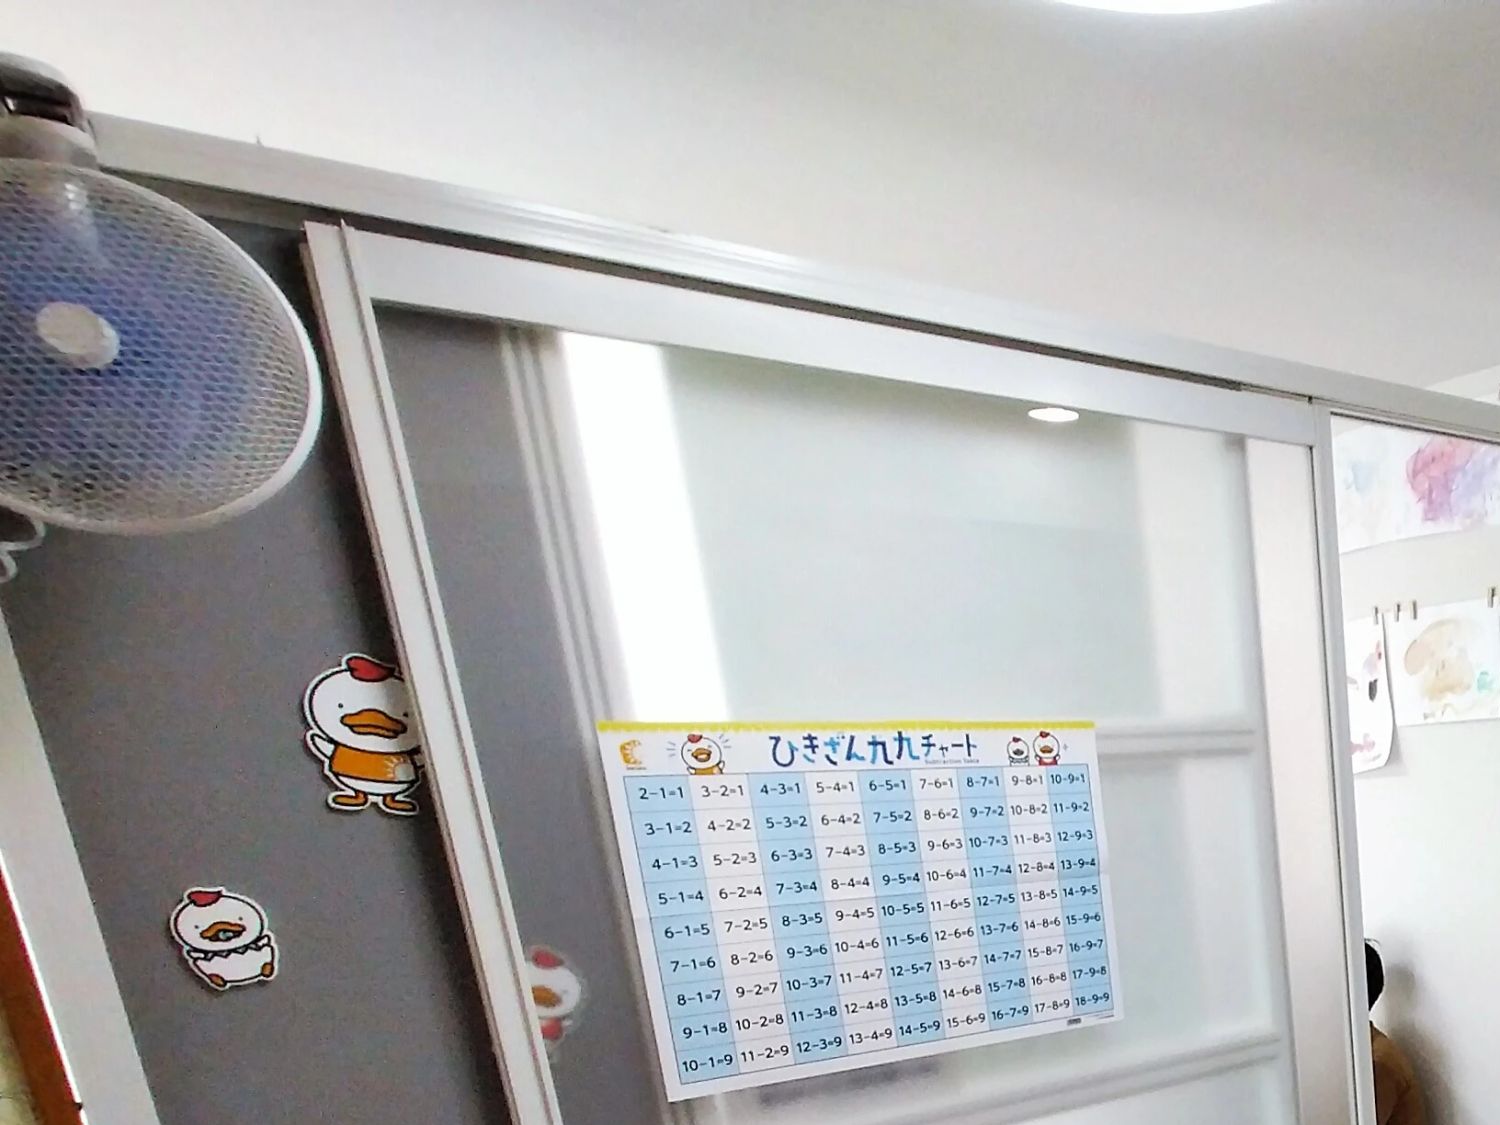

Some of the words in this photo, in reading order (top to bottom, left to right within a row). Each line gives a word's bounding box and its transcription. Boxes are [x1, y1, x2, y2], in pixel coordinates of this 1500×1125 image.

[769, 731, 978, 767] ひきざん九九チャート
[637, 785, 684, 801] 2-1=1
[700, 784, 744, 798] 3-2=1
[759, 782, 801, 796] 4-3=1
[815, 780, 855, 794] 5-4=1
[868, 778, 907, 792] 6-5=1
[919, 777, 954, 790] 7-6=1
[966, 775, 1000, 788] 8-7=1
[1011, 774, 1044, 787] 9-8=1
[1049, 772, 1086, 785] 10-9=1
[643, 820, 693, 836] 3-1=2
[707, 817, 752, 832] 4-2=2
[765, 815, 809, 830] 5-3=2
[820, 812, 862, 827] 6-4=2
[872, 809, 913, 824] 7-5=2
[923, 807, 960, 821] 8-6=2
[969, 804, 1005, 819] 9-7=2
[1010, 803, 1048, 816] 10-8=2
[1053, 801, 1089, 815] 11-9=2
[651, 855, 699, 871] 4-1=3
[712, 851, 757, 867] 5-2=3
[770, 847, 814, 863] 6-3=3
[825, 844, 866, 859] 7-4=3
[877, 840, 917, 855] 8-5=3
[927, 837, 964, 852] 9-6=3
[968, 834, 1009, 849] 10-7=3
[1013, 831, 1052, 845] 11-8=3
[1056, 828, 1094, 842] 12-9=3
[657, 889, 705, 906] 5-1=4
[718, 885, 763, 900] 6-2=4
[775, 880, 818, 896] 7-3=4
[830, 876, 871, 891] 8-4=4
[881, 871, 921, 886] 9-5=4
[926, 868, 967, 882] 10-6=4
[972, 863, 1013, 878] 11-7=4
[1017, 861, 1056, 874] 12-8=4
[1059, 857, 1096, 870] 13-9=4
[663, 922, 711, 940] 6-1=5
[723, 917, 769, 933] 7-2=5
[781, 911, 824, 928] 8-3=5
[834, 906, 875, 922] 9-4=5
[880, 901, 925, 917] 10-5=5
[930, 897, 972, 912] 11-6=5
[976, 892, 1016, 907] 12-7=5
[1020, 888, 1058, 903] 13-8=5
[1062, 884, 1099, 898] 14-9=5
[669, 955, 717, 973] 7-1=6
[730, 949, 774, 966] 8-2=6
[786, 943, 829, 959] 9-3=6
[834, 937, 880, 953] 10-4=6
[885, 931, 929, 948] 11-5=6
[934, 926, 975, 942] 12-6=6
[979, 921, 1020, 936] 13-7=6
[1024, 916, 1062, 931] 14-8=6
[1065, 911, 1102, 926] 15-9=6
[676, 988, 722, 1007] 8-1=7
[735, 981, 779, 999] 9-2=7
[785, 974, 832, 992] 10-3=7
[839, 967, 884, 984] 11-4=7
[889, 961, 933, 978] 12-5=7
[938, 955, 978, 971] 13-6=7
[983, 949, 1022, 965] 14-7=7
[1027, 943, 1064, 959] 15-8=7
[1068, 938, 1104, 953] 16-9=7
[682, 1021, 729, 1040] 9-1=8
[735, 1013, 785, 1031] 10-2=8
[790, 1005, 838, 1023] 11-3=8
[844, 997, 889, 1015] 12-4=8
[893, 990, 938, 1007] 13-5=8
[942, 983, 983, 1000] 14-6=8
[987, 977, 1026, 993] 15-7=8
[1030, 971, 1068, 987] 16-8=8
[1071, 965, 1107, 980] 17-9=8
[681, 1053, 734, 1074] 10-1=9
[740, 1044, 790, 1063] 11-2=9
[795, 1035, 842, 1054] 12-3=9
[848, 1027, 894, 1045] 13-4=9
[899, 1019, 942, 1037] 14-5=9
[946, 1012, 986, 1029] 15-6=9
[990, 1004, 1030, 1022] 16-7=9
[1034, 998, 1071, 1014] 17-8=9
[1074, 991, 1110, 1007] 18-9=9
